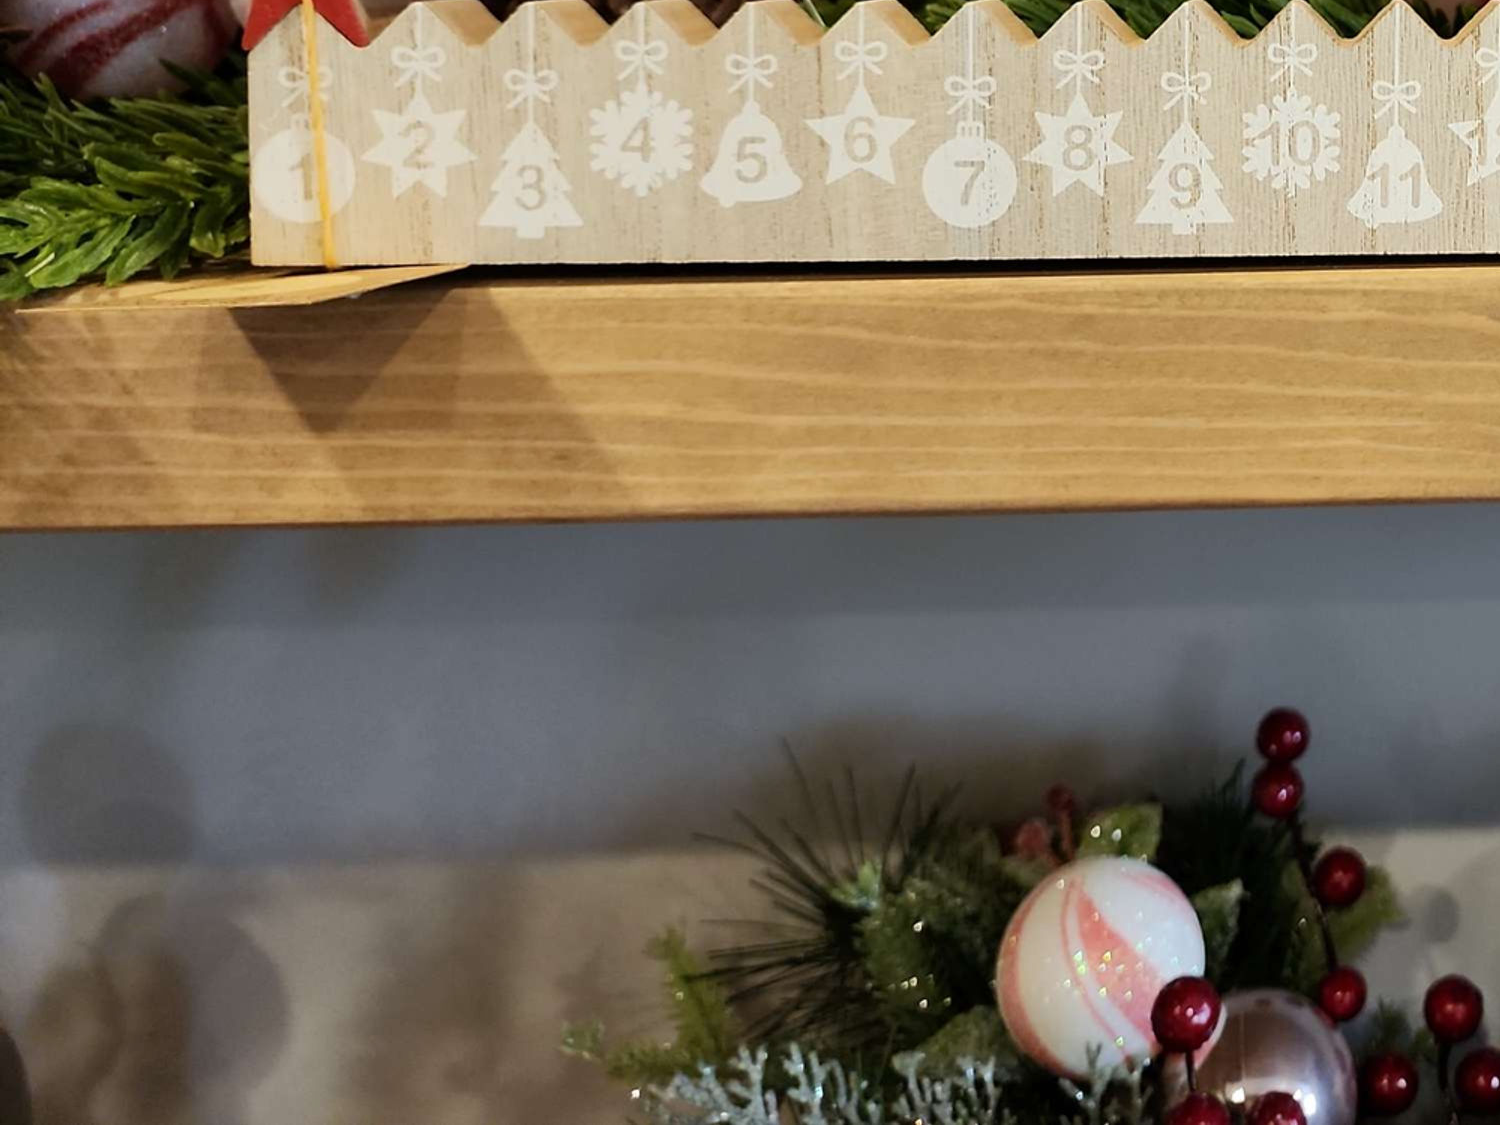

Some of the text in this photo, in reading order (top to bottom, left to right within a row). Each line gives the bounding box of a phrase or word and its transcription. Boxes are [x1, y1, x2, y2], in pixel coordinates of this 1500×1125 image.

[288, 149, 316, 203] 1
[398, 120, 438, 171] 2
[515, 163, 548, 212] 3
[619, 115, 656, 166] 4
[734, 135, 769, 185] 5
[843, 114, 878, 164] 6
[953, 159, 987, 207] 7
[1061, 124, 1096, 172] 8
[1167, 162, 1202, 211] 9
[1256, 119, 1322, 168] 10
[1365, 161, 1424, 209] 11
